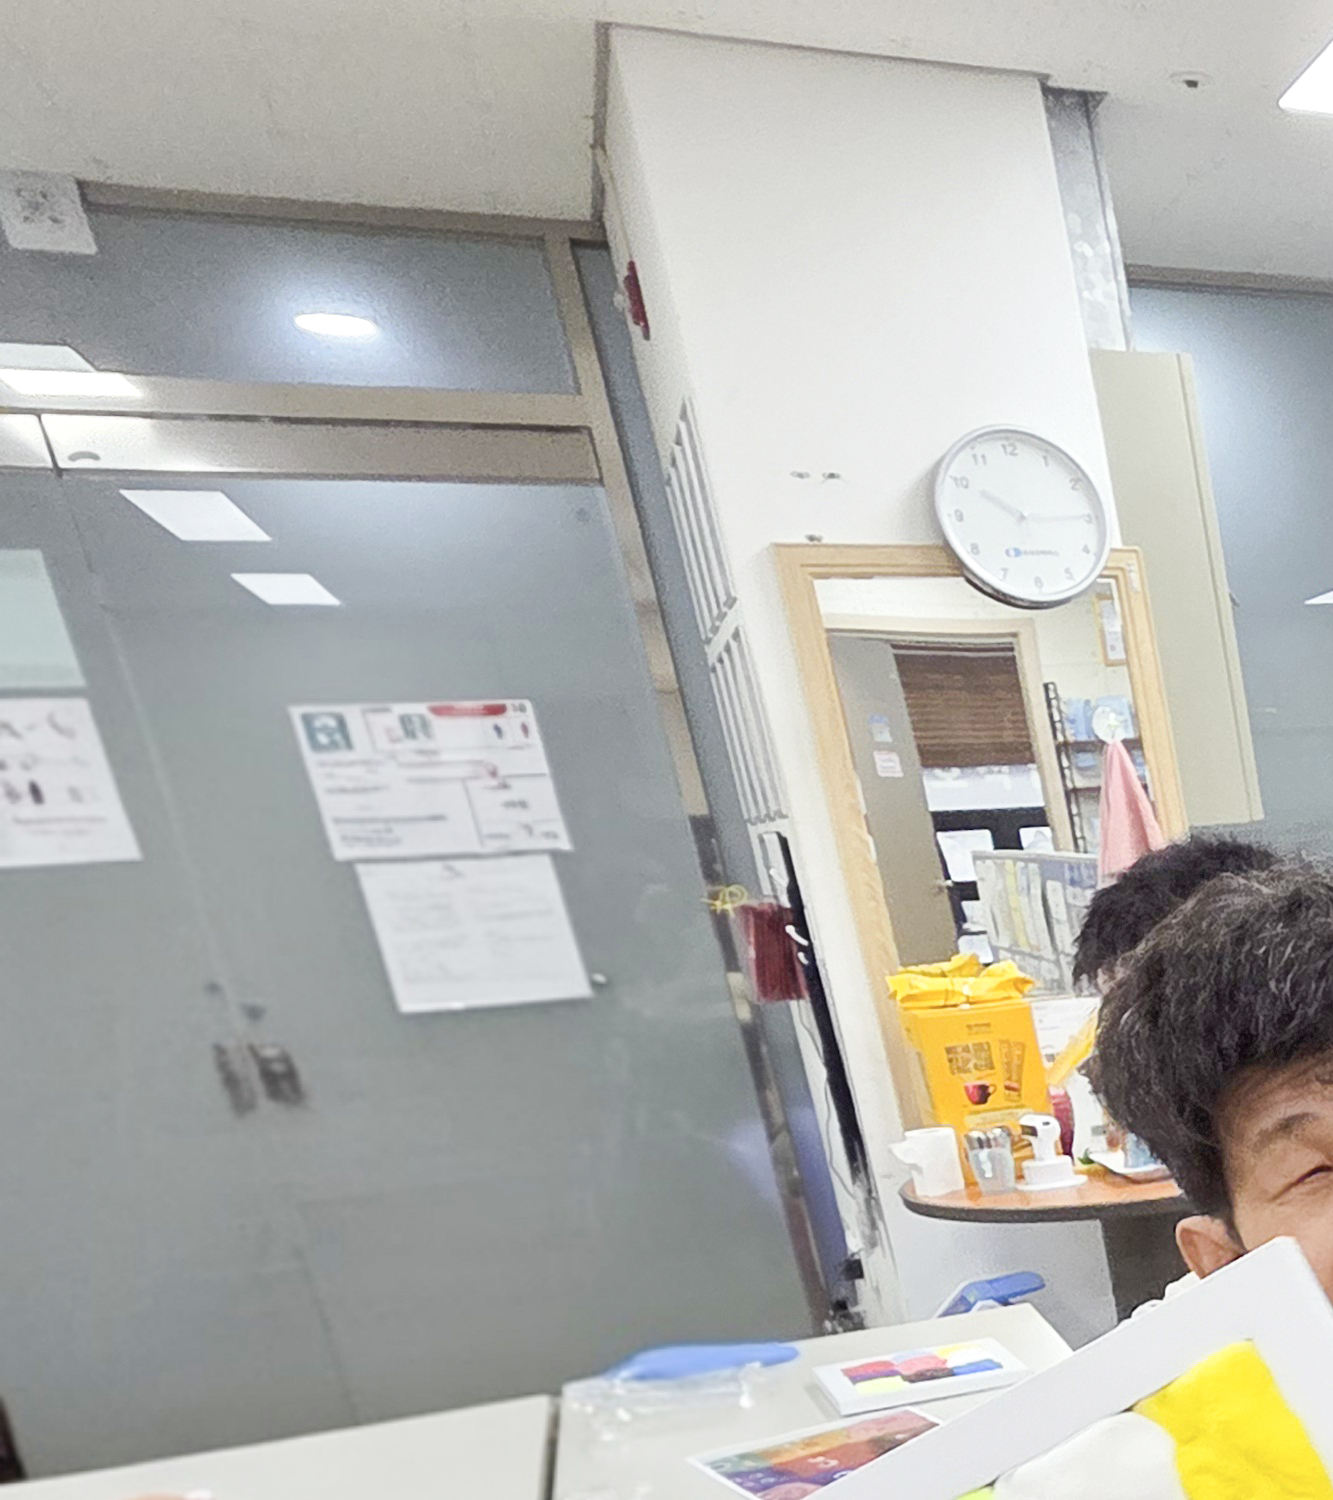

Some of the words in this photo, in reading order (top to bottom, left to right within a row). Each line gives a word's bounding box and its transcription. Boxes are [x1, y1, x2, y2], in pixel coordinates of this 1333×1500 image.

[1001, 443, 1018, 456] 12
[972, 453, 987, 465] 11
[953, 476, 969, 489] 10
[1069, 478, 1082, 491] 2
[954, 509, 964, 522] 9
